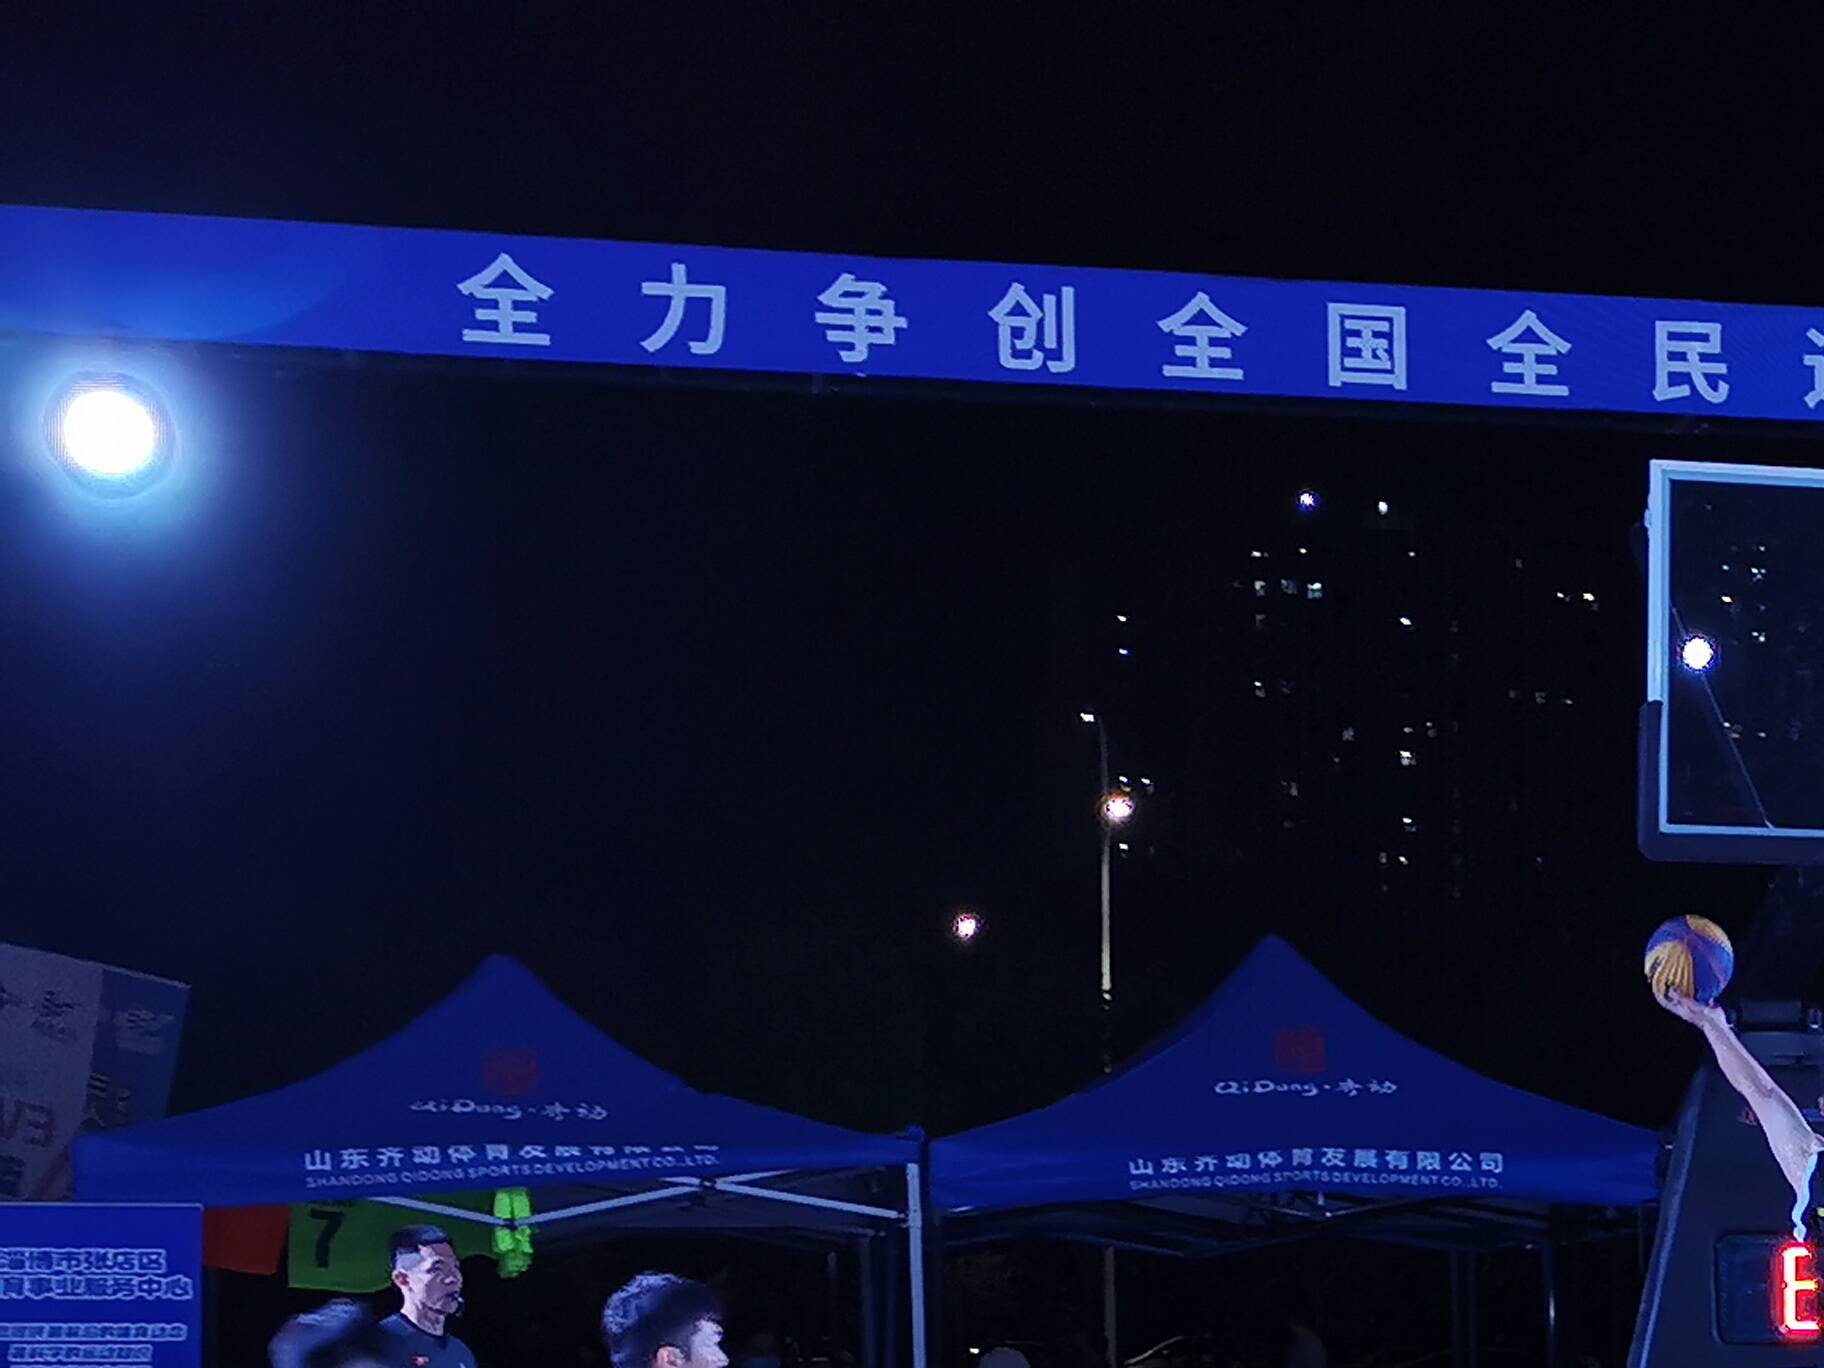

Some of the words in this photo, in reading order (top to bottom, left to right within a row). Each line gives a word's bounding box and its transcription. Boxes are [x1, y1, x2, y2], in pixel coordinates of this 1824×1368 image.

[467, 1163, 530, 1179] SPORTS
[1129, 1148, 1504, 1174] 山东齐动体育发展有限公司
[1273, 1169, 1330, 1184] SPORTS
[310, 1208, 345, 1268] 7
